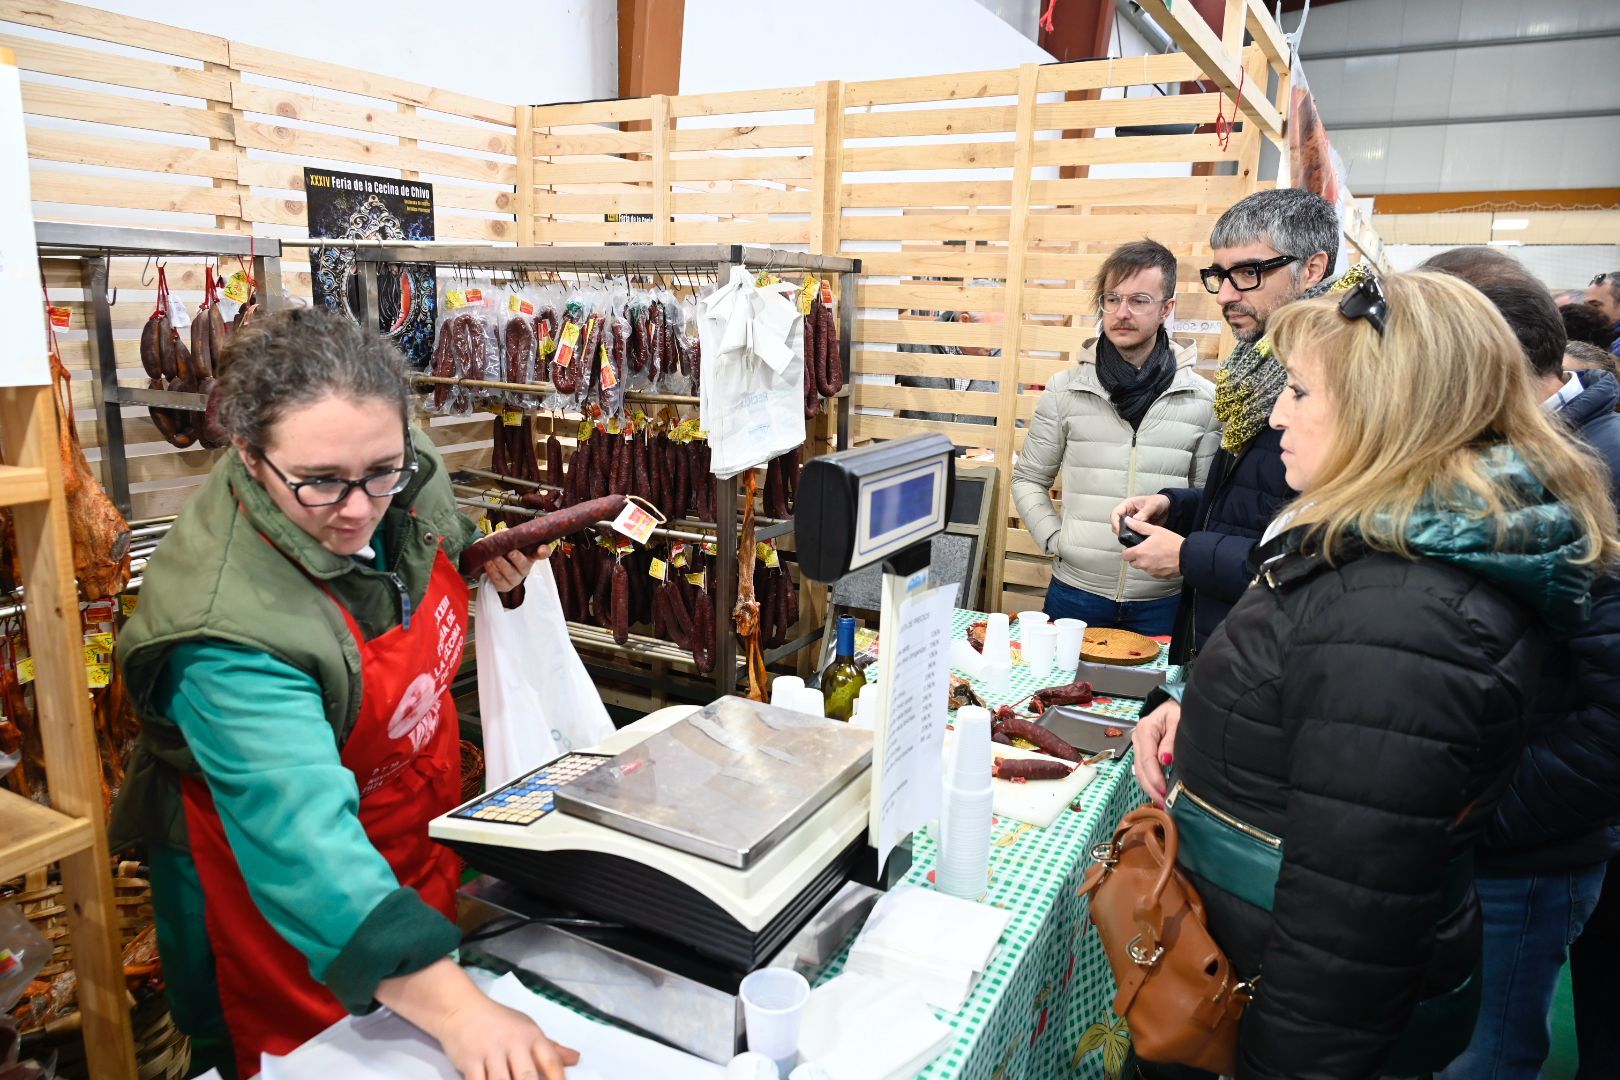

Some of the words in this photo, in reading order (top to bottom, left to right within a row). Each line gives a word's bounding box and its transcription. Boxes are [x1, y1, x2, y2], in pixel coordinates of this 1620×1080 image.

[310, 174, 330, 188] XXXIV
[331, 176, 352, 190] Feria
[353, 179, 364, 192] de
[364, 180, 373, 193] la
[373, 181, 400, 196] Cecina
[400, 184, 410, 197] de
[410, 185, 430, 199] Chivo
